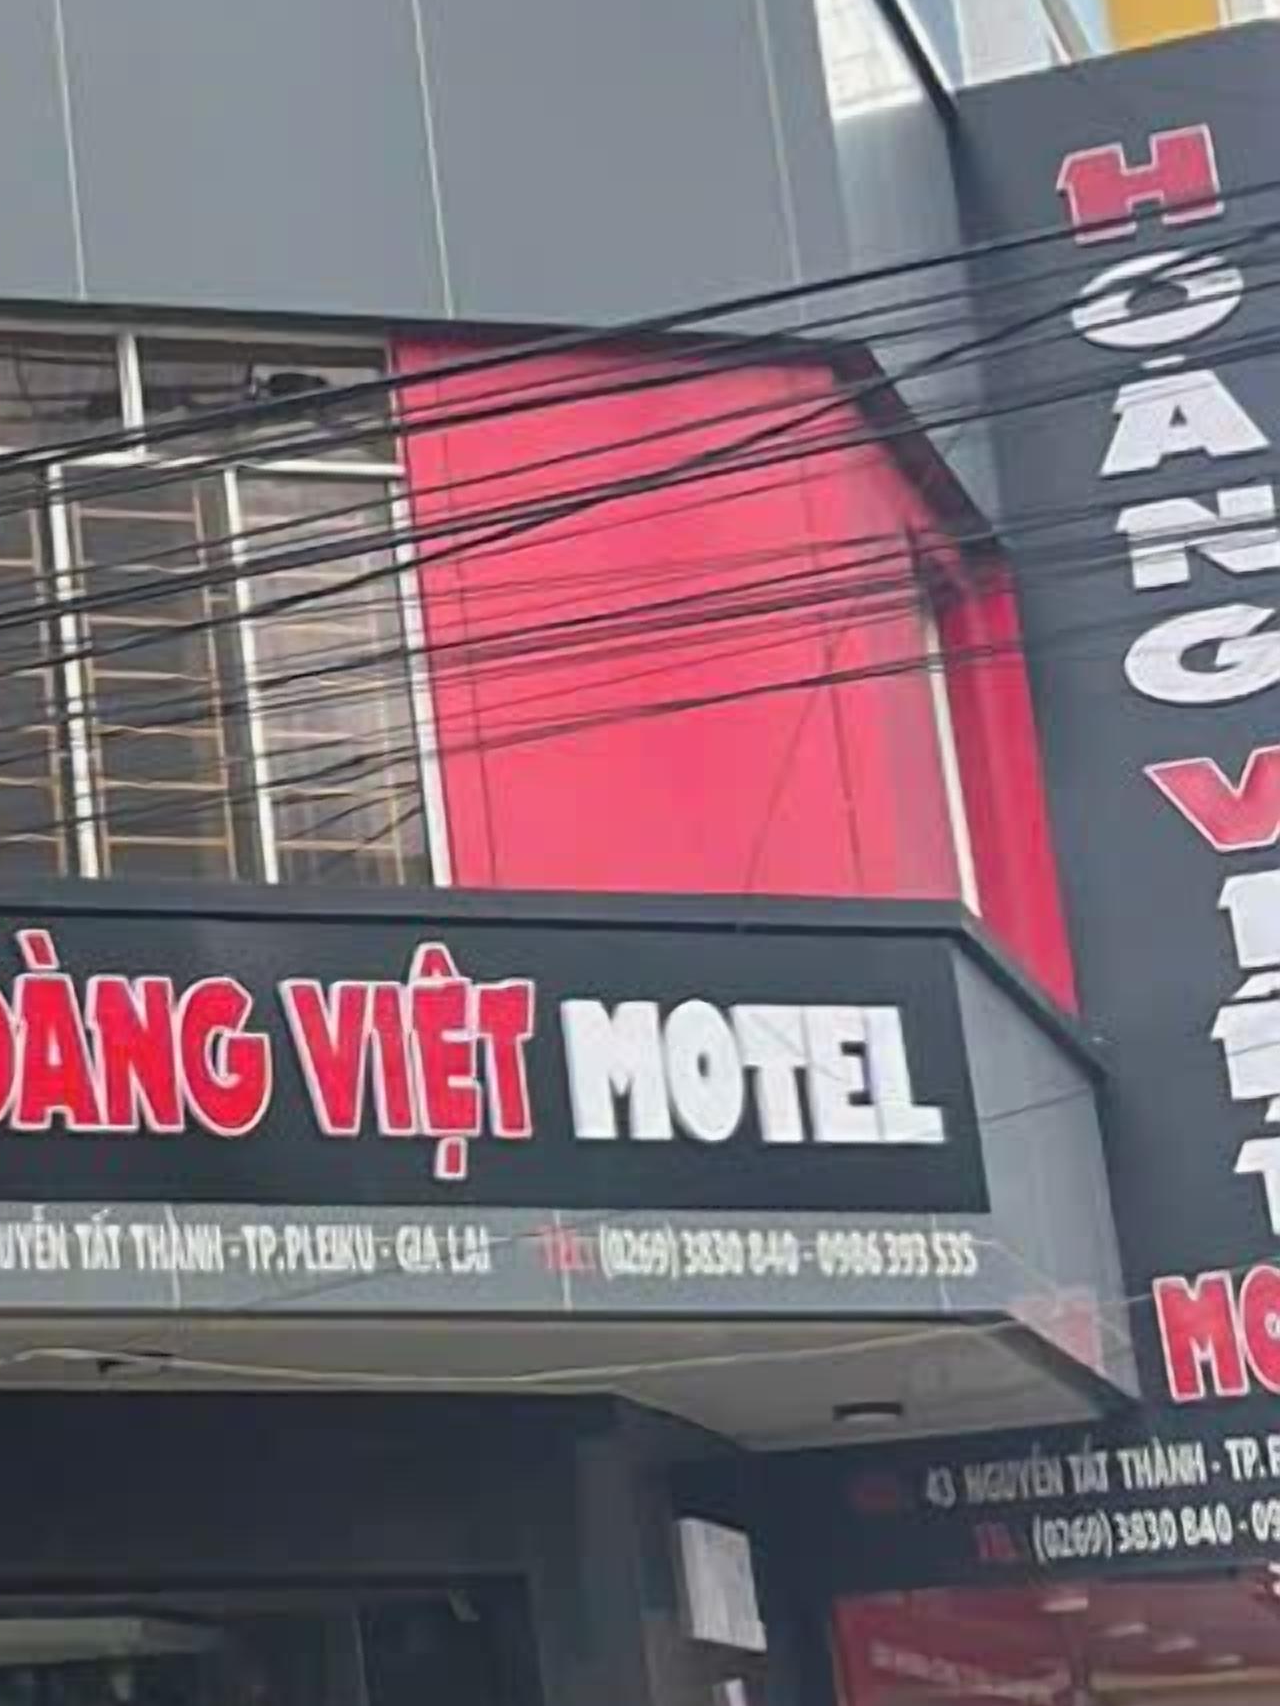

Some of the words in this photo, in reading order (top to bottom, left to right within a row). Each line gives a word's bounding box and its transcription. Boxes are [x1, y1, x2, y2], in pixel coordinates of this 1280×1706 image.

[278, 941, 536, 1180] VIỆT
[559, 998, 945, 1144] MOTEL
[599, 1222, 679, 1281] (0269)
[1032, 1508, 1113, 1567] (0269)
[1112, 1506, 1179, 1554] 3830
[1180, 1502, 1233, 1547] 840
